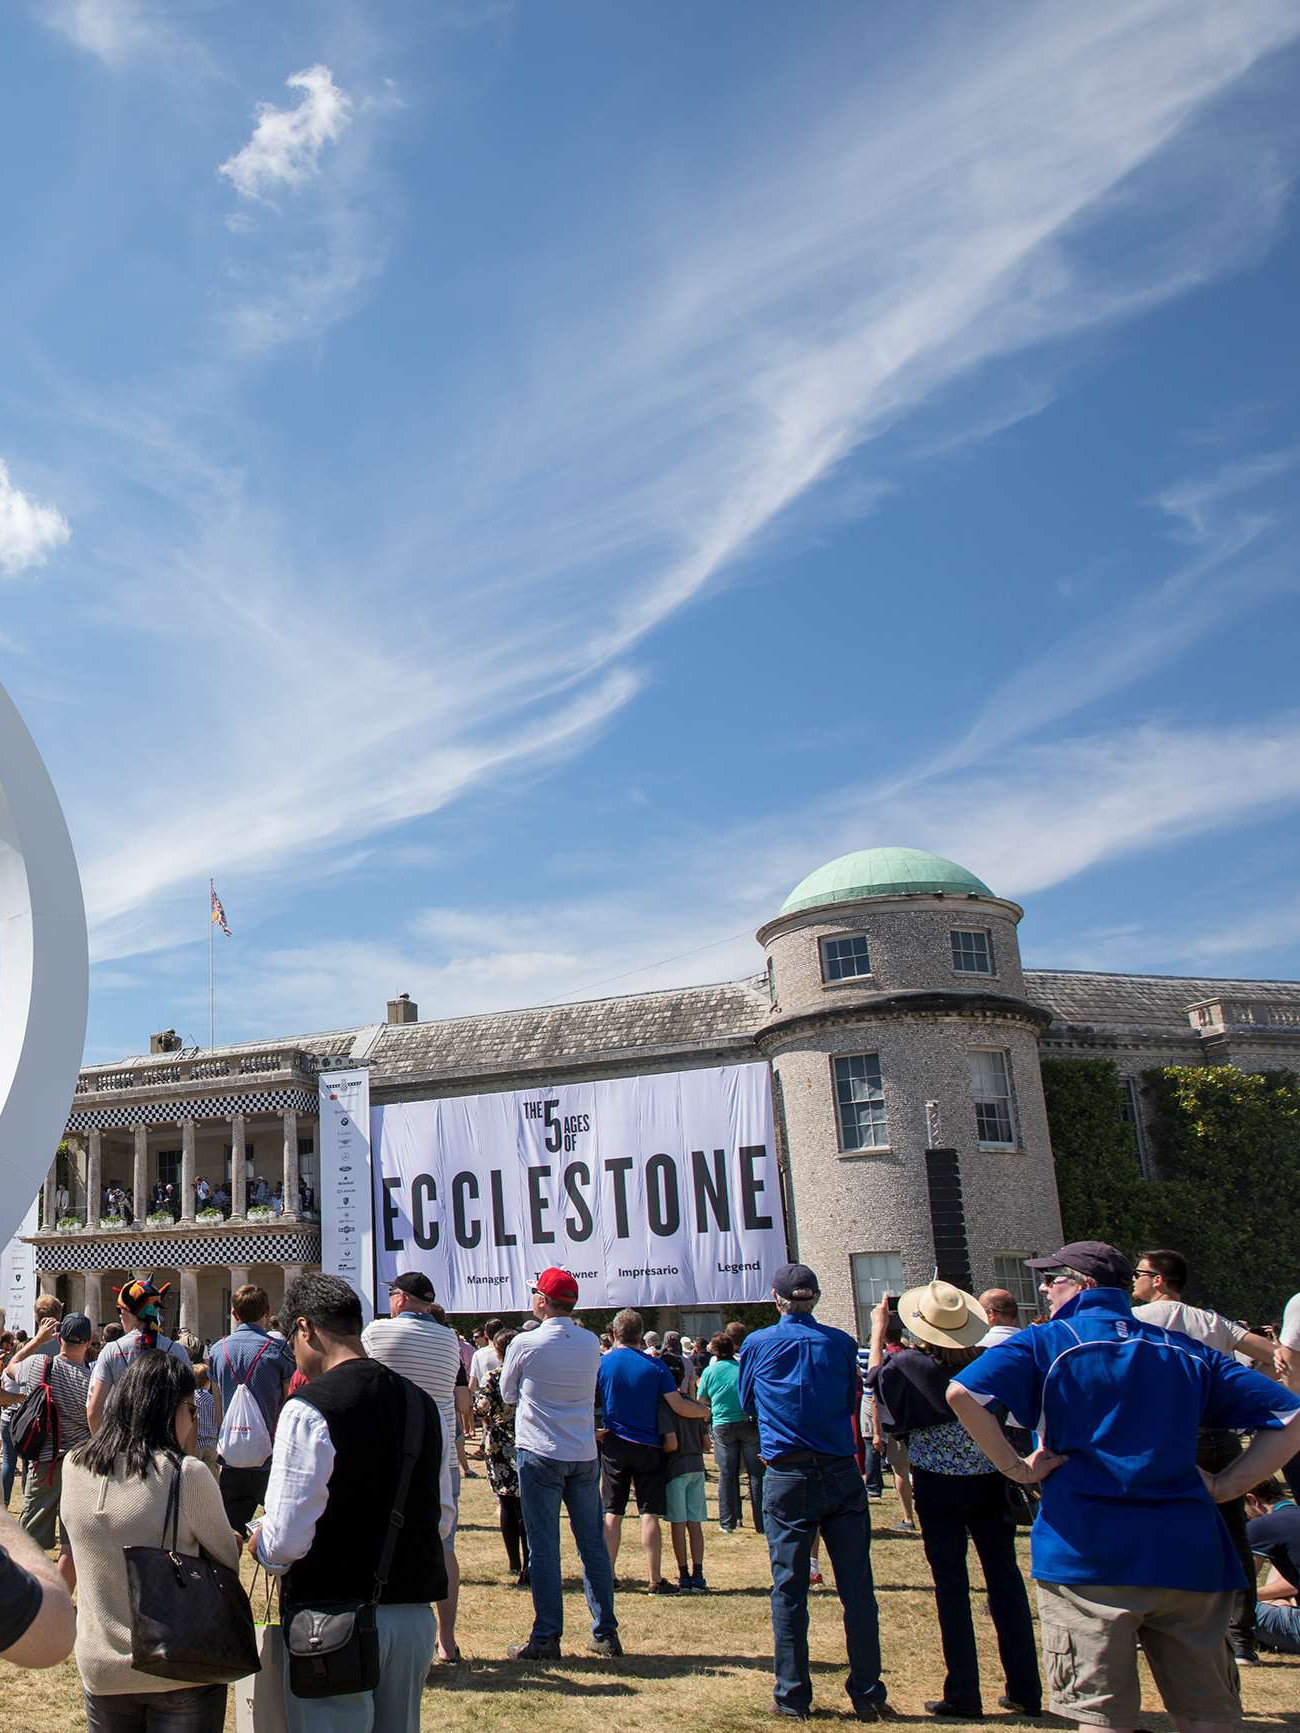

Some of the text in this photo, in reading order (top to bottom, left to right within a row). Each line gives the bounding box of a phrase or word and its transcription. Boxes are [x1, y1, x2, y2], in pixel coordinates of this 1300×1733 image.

[523, 1099, 590, 1153] THE 5 AGES
[564, 1134, 577, 1152] OF
[382, 1144, 773, 1252] ECCLESTONE
[618, 1265, 679, 1279] Impresario
[717, 1261, 761, 1274] Legend
[467, 1275, 509, 1286] Manager
